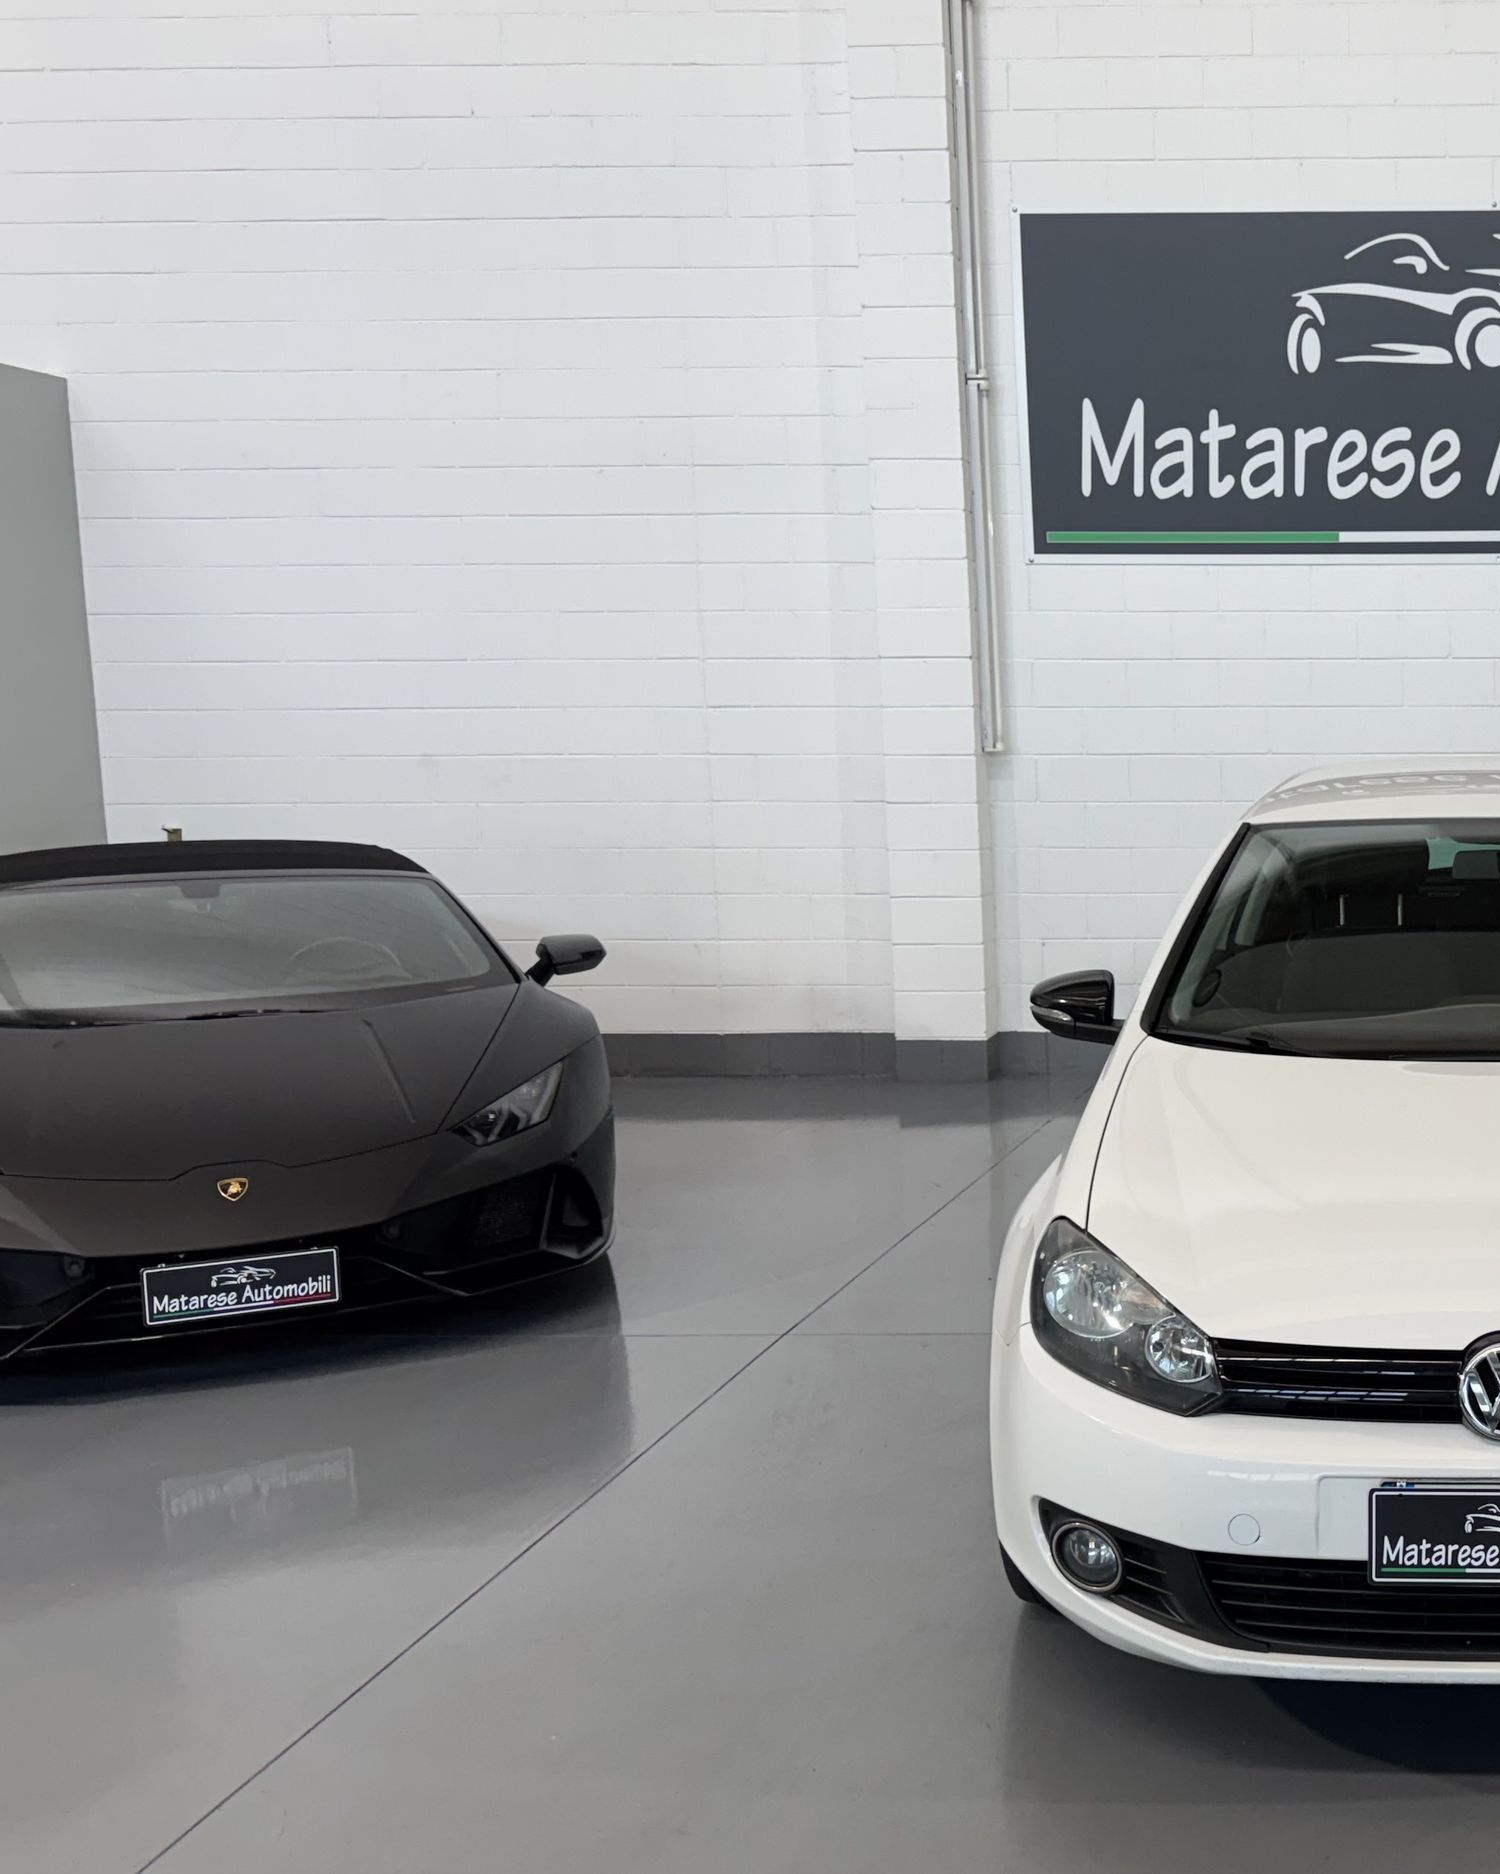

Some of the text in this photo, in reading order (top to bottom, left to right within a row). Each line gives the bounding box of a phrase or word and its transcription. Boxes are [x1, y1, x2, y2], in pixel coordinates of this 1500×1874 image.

[1081, 397, 1462, 500] Matarese
[152, 1274, 331, 1315] Matarese Automobili
[1382, 1535, 1500, 1567] Matarese
